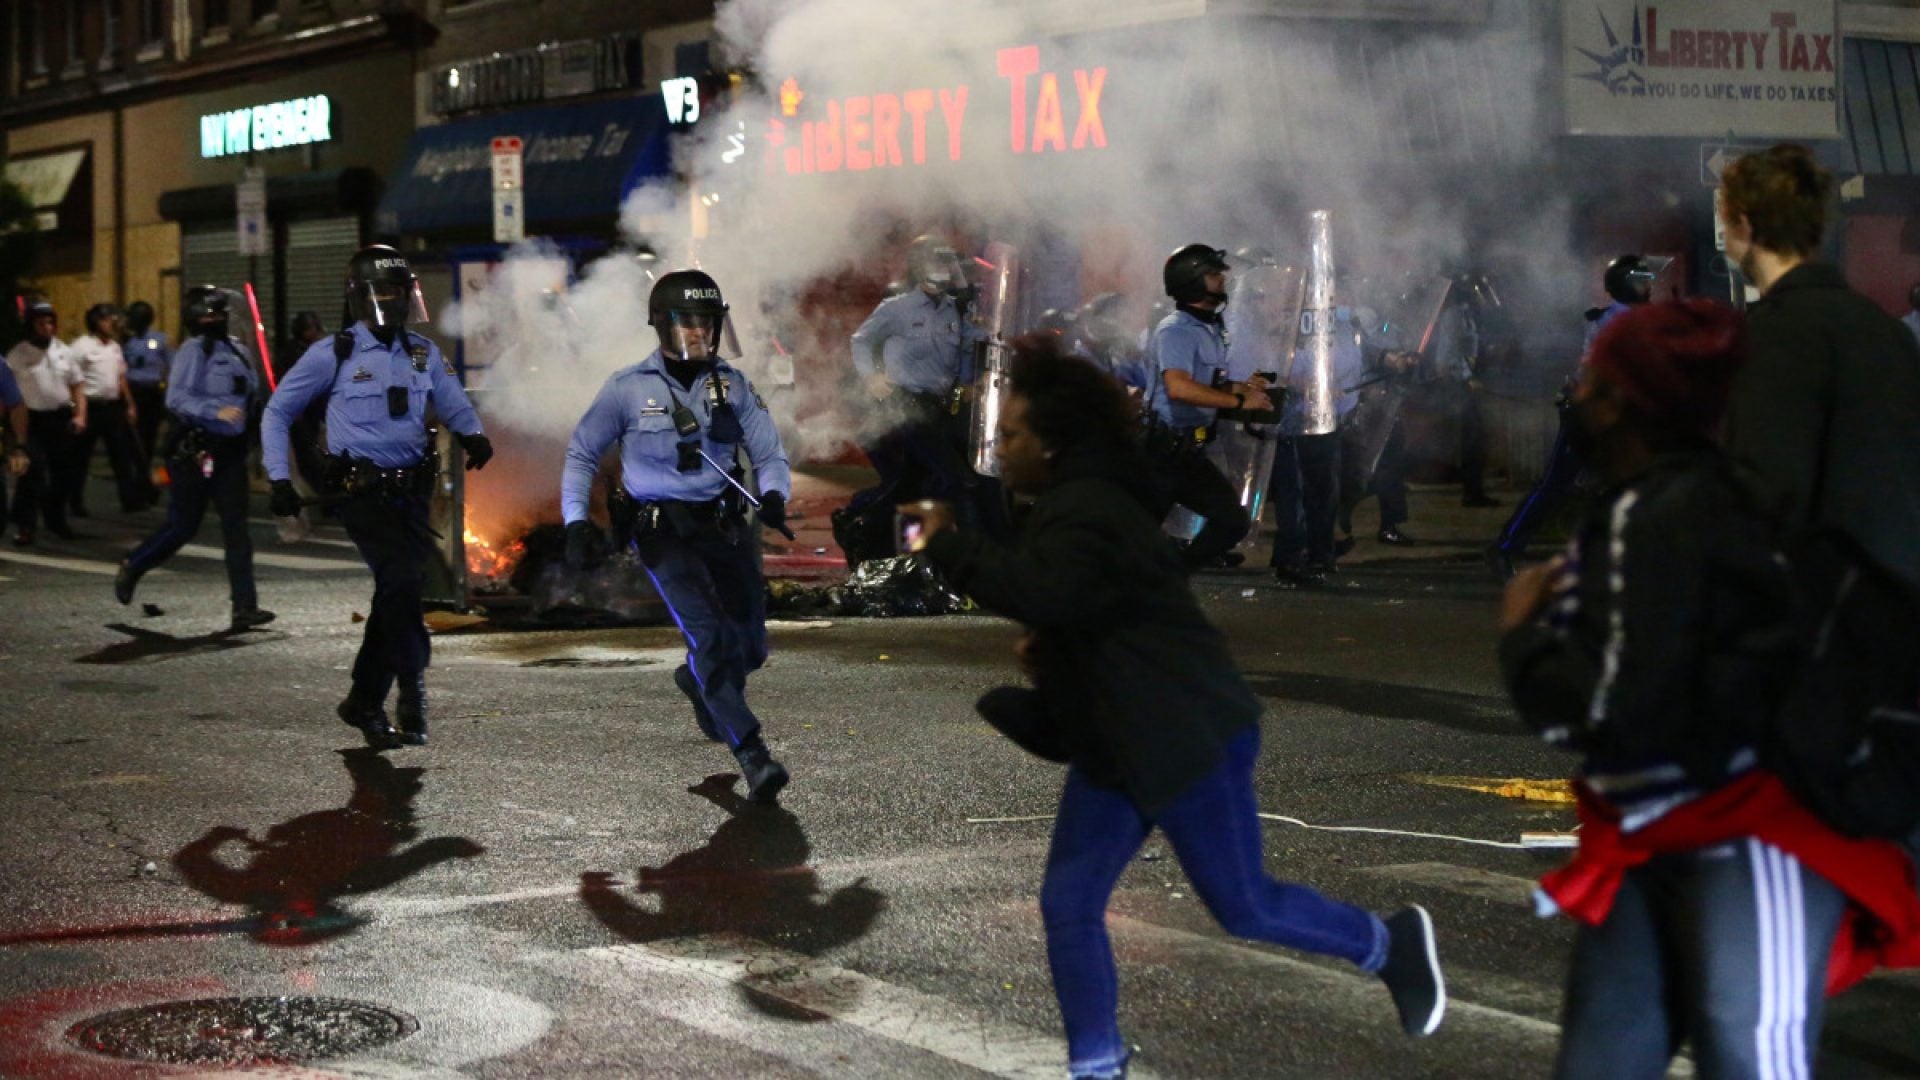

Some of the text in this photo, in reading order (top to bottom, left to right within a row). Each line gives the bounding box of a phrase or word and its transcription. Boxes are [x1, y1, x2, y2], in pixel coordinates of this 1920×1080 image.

[1647, 7, 1834, 73] LIBERTY TAX
[996, 46, 1108, 153] TAX
[1648, 83, 1675, 98] YOU
[1680, 83, 1700, 98] DO
[1767, 85, 1786, 101] DO
[1790, 86, 1836, 102] TAXES
[374, 258, 407, 269] POLICE
[684, 287, 719, 299] POLICE
